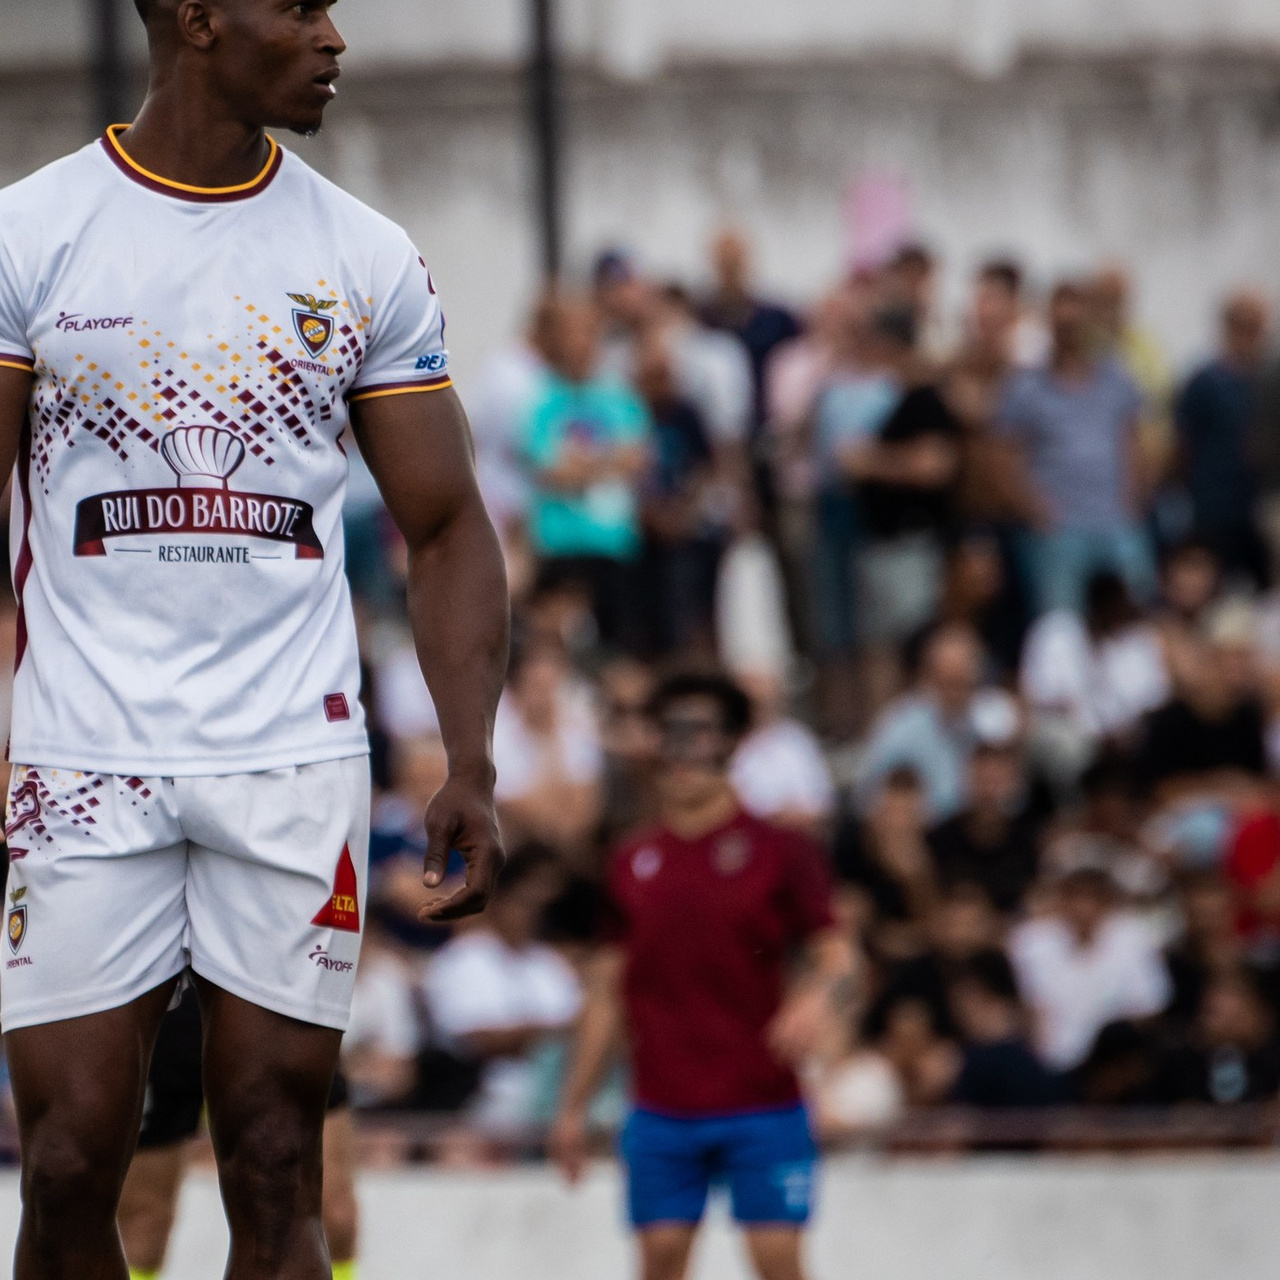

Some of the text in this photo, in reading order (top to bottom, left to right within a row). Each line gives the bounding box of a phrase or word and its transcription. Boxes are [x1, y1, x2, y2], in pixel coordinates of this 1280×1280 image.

[63, 317, 134, 333] PLAYOFF
[290, 358, 331, 376] ORIENTAL
[101, 494, 304, 538] RUI DO BARROTE
[158, 545, 250, 564] RESTAURANTE
